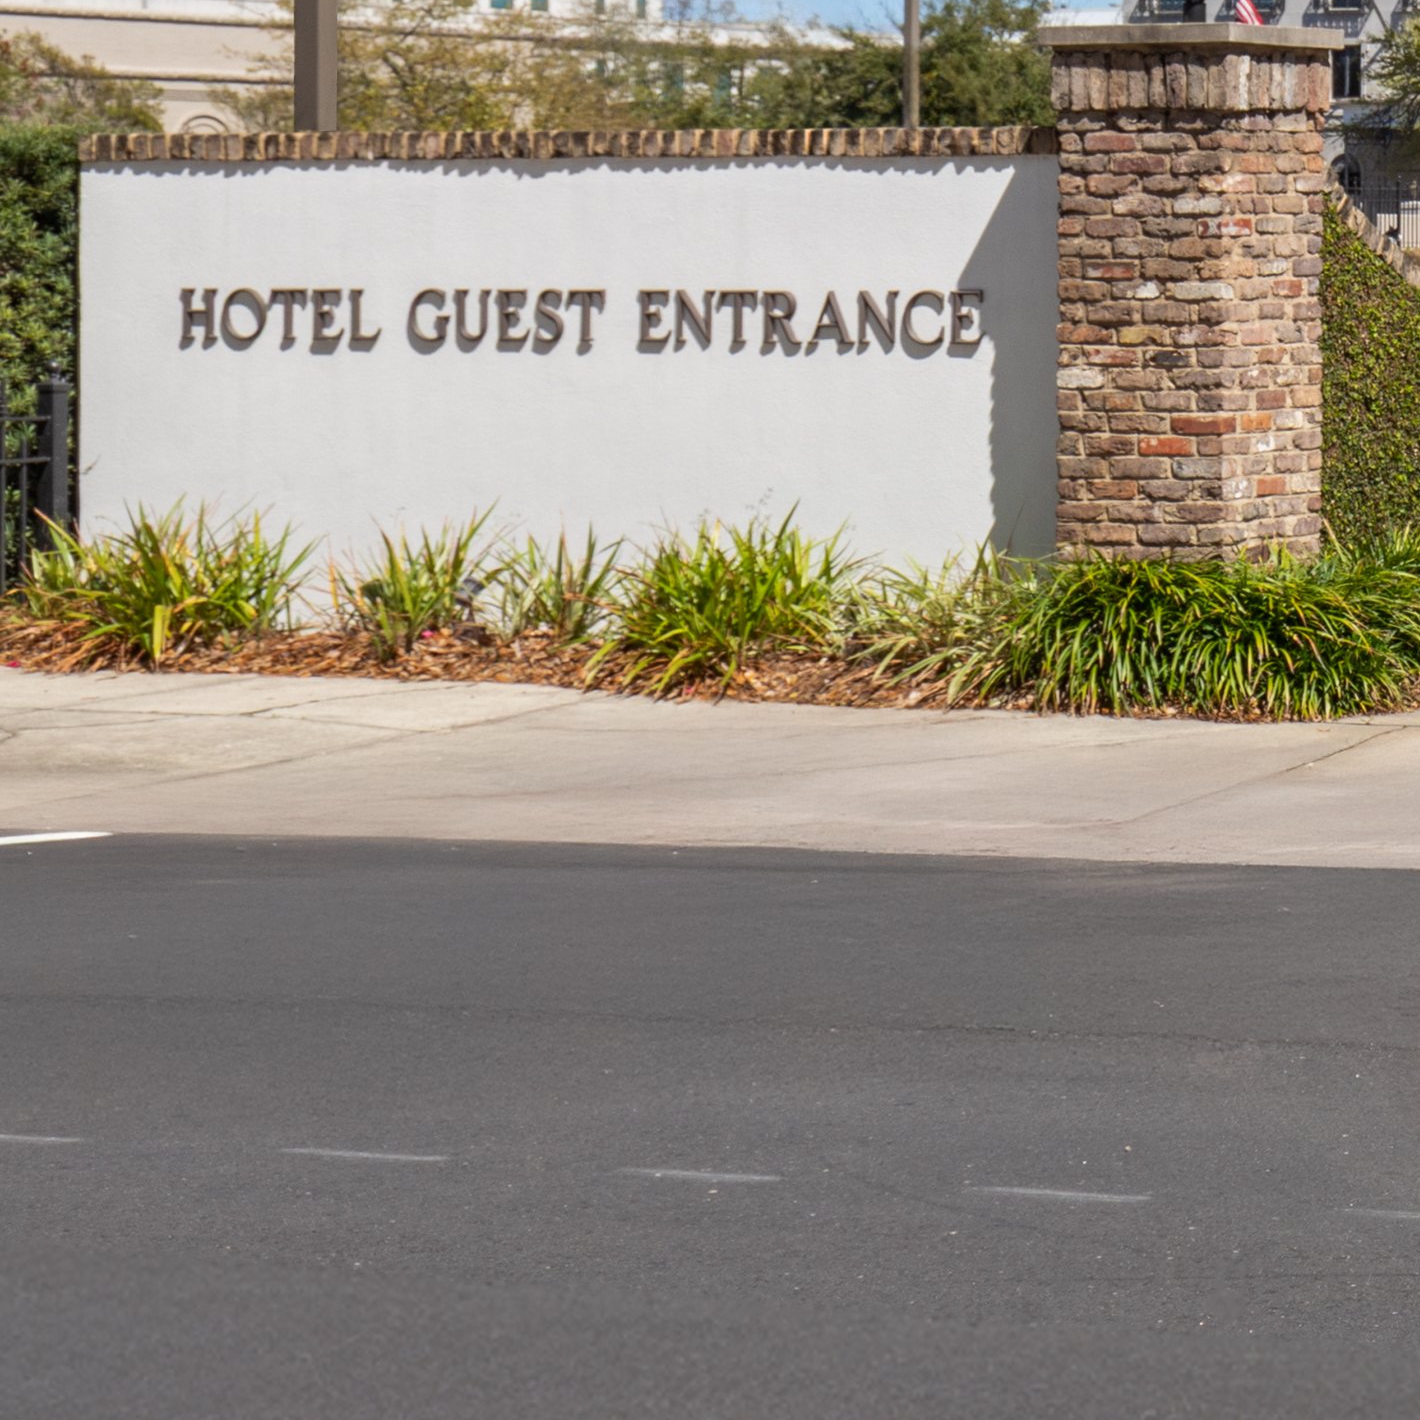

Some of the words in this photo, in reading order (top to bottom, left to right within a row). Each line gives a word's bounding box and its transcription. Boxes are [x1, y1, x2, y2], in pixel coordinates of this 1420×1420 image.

[180, 288, 382, 342] HOTEL
[406, 288, 606, 343] GUEST
[638, 288, 986, 346] ENTRANCE
